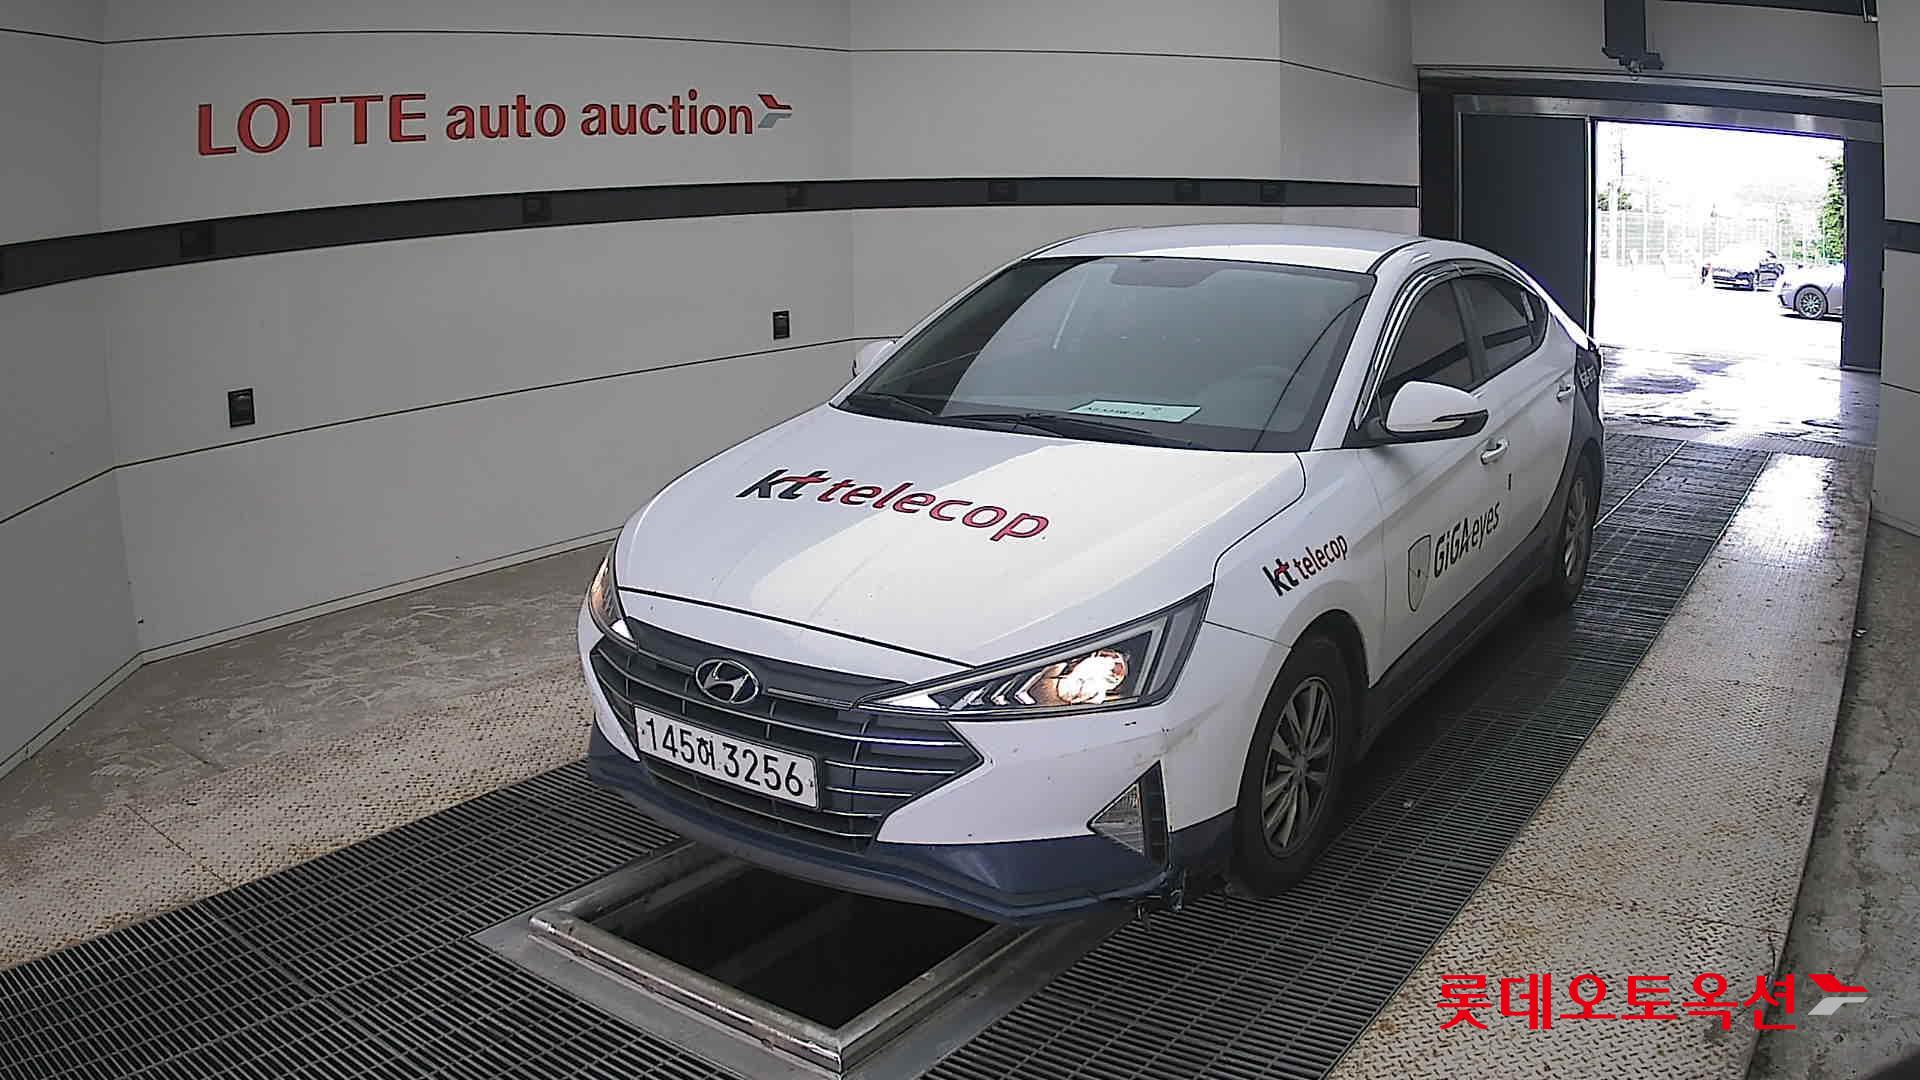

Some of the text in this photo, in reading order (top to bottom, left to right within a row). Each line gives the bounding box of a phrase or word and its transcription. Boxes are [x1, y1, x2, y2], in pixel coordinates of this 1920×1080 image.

[197, 88, 753, 156] LOTTE auto auction
[735, 469, 1049, 542] kt telecop
[1262, 534, 1348, 597] kt telecop
[722, 742, 804, 796] 3256
